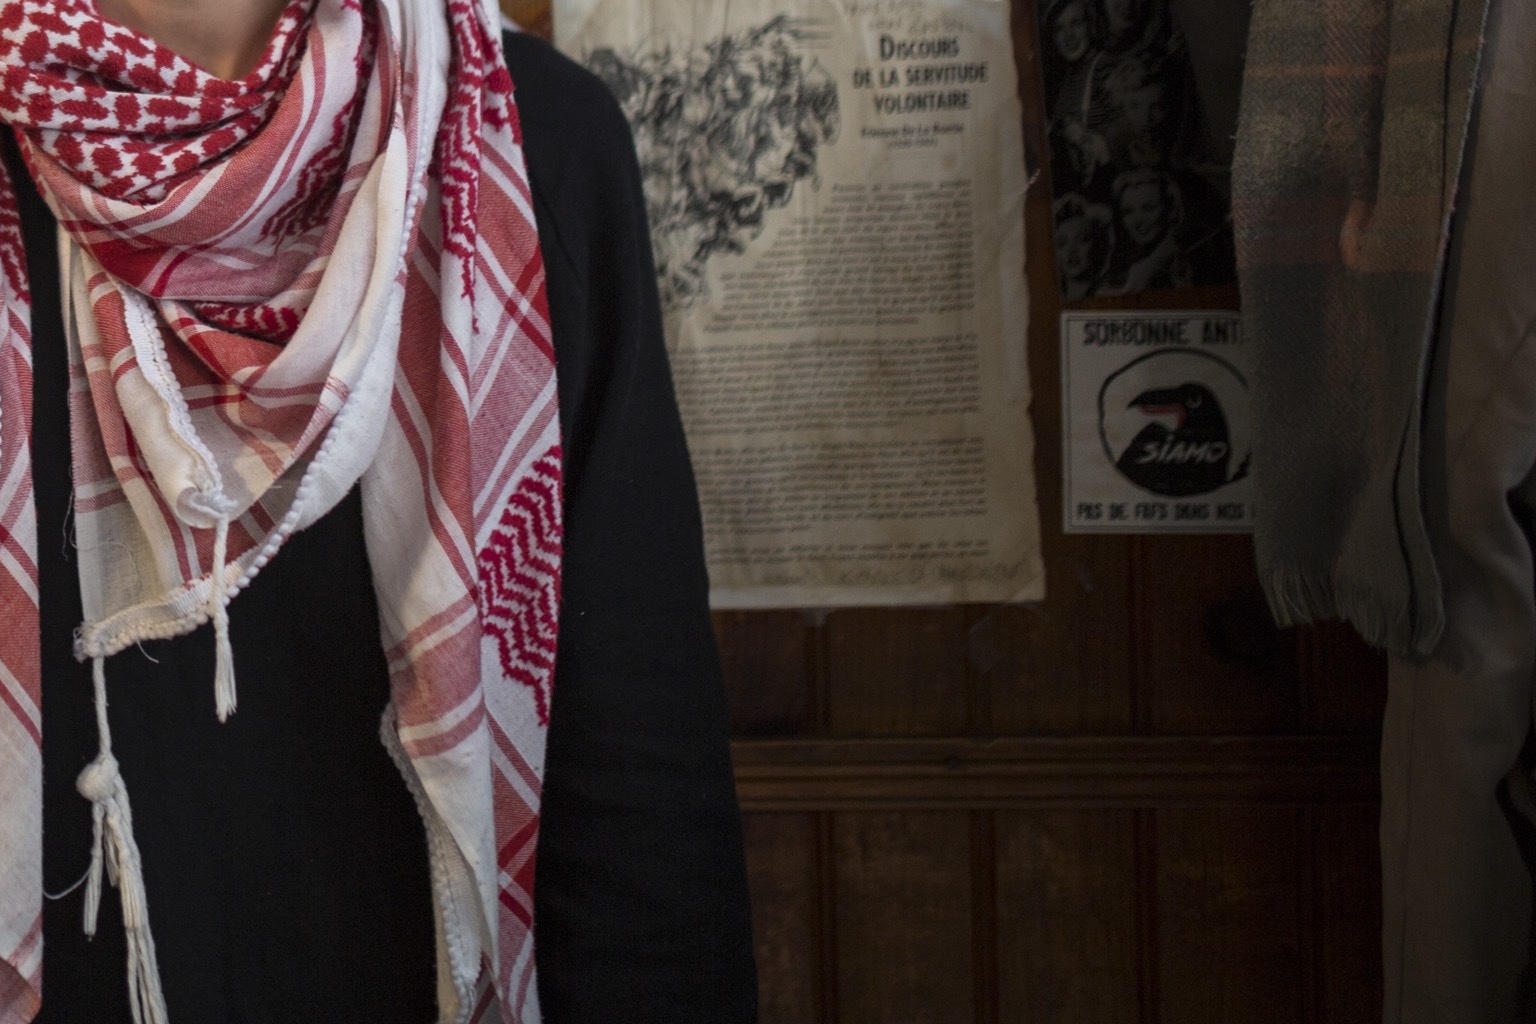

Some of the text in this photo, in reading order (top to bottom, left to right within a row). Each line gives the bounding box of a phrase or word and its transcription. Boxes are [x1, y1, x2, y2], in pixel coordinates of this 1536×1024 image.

[905, 61, 989, 86] SERVITUDE
[873, 90, 972, 115] VOLONTAIRE
[1084, 319, 1189, 346] SORBONNE
